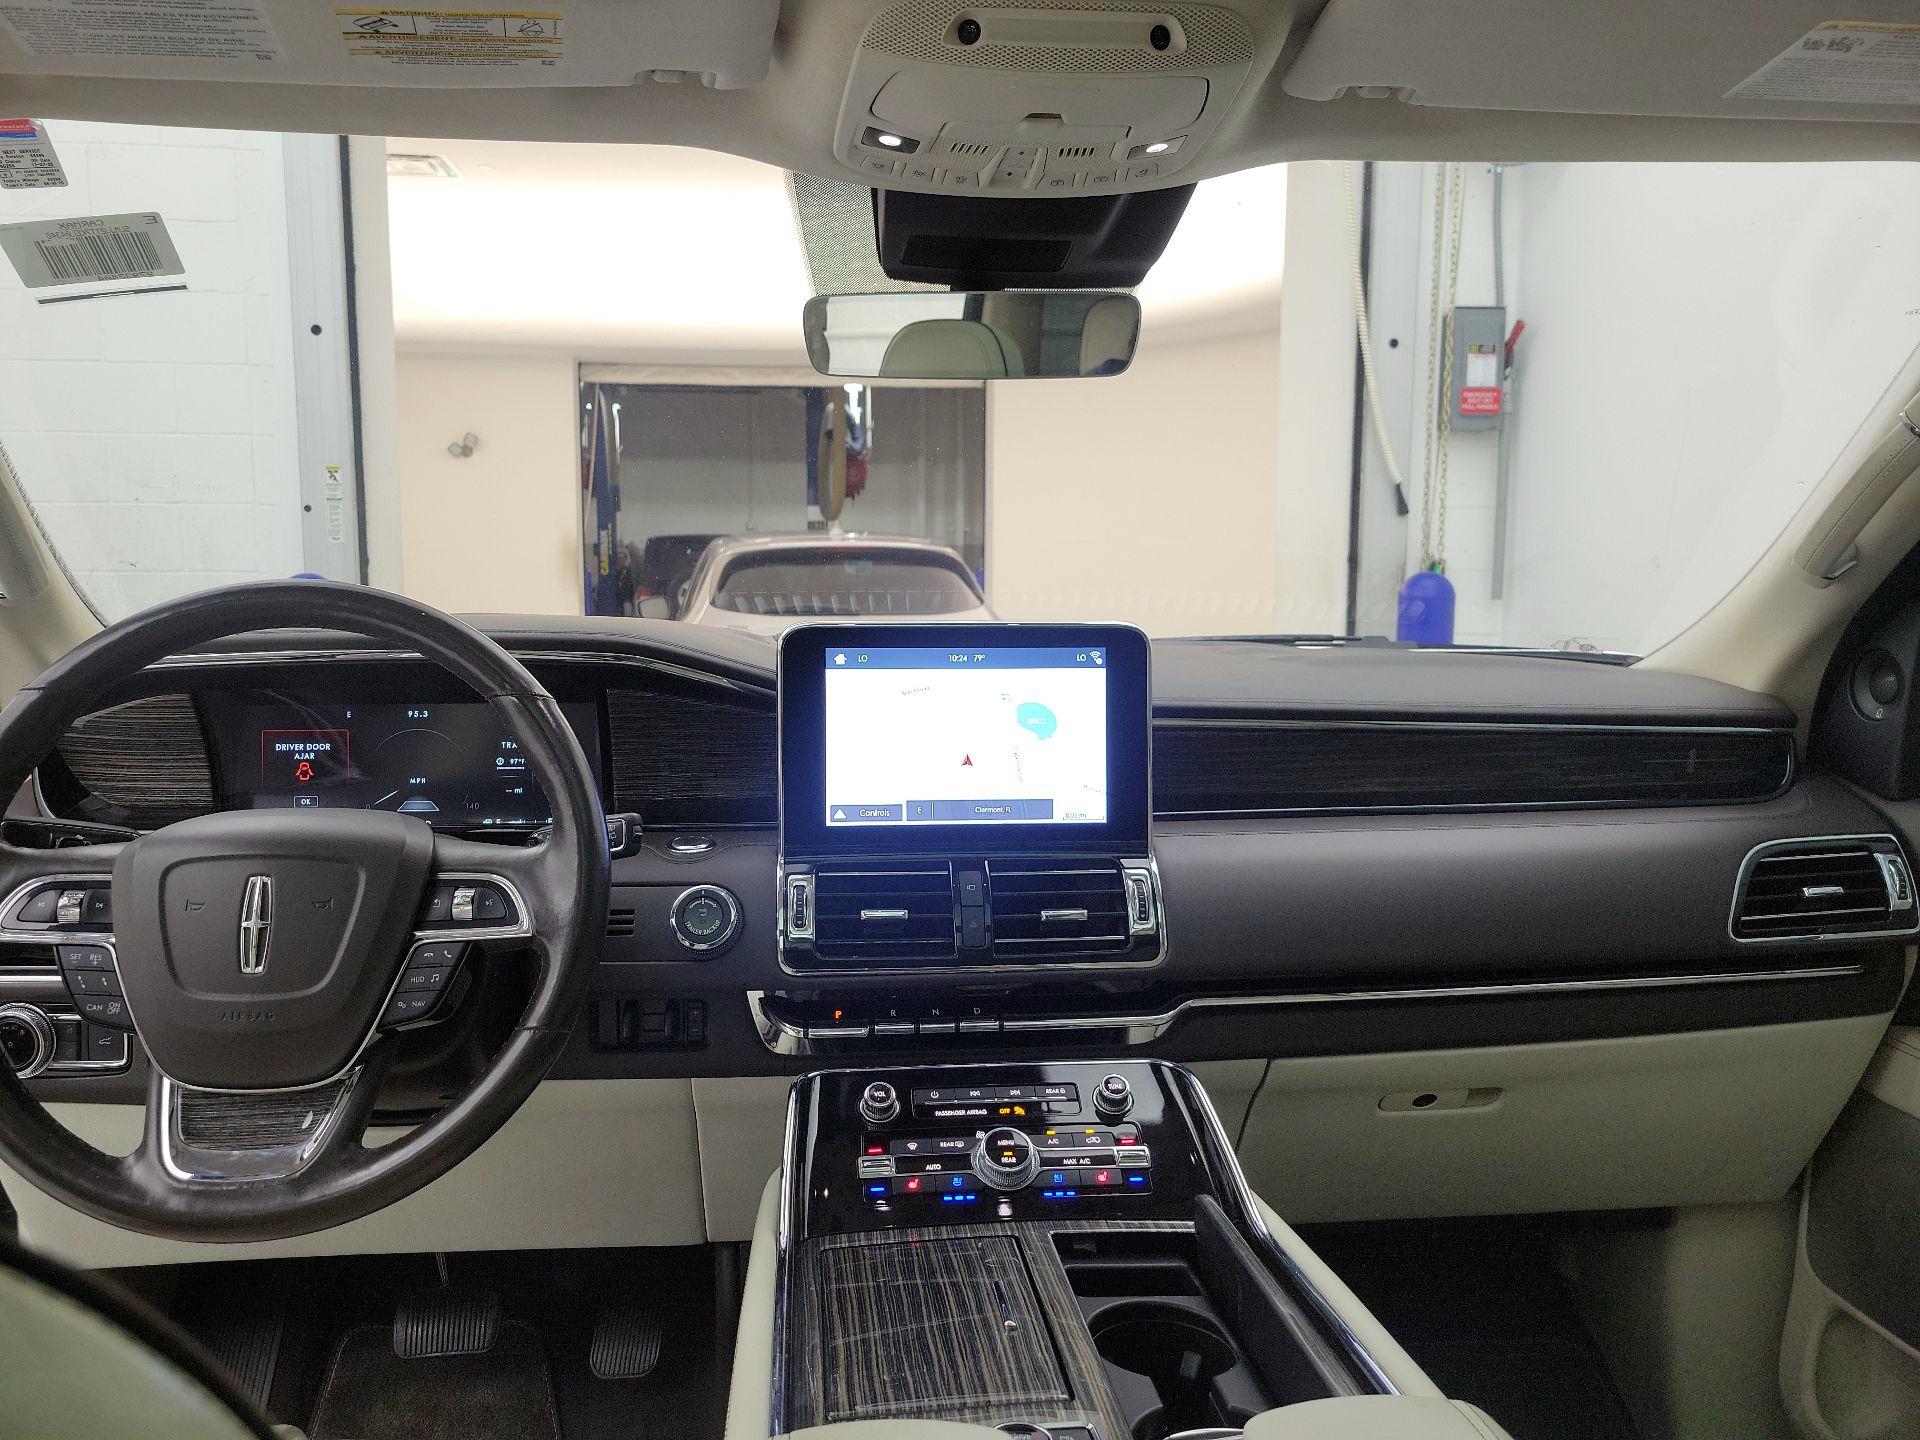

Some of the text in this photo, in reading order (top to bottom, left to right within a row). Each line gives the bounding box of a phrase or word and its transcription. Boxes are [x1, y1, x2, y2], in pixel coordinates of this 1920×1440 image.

[857, 653, 869, 663] LO
[948, 653, 969, 663] 10:24
[1076, 653, 1087, 662] LO
[346, 711, 352, 719] E
[407, 710, 430, 718] 95.3
[275, 742, 331, 752] DRIVER DOOR
[294, 752, 316, 760] AJAR
[409, 777, 427, 785] MPH
[300, 798, 311, 806] OK
[464, 802, 480, 810] 140
[859, 808, 892, 818] Controls
[917, 806, 922, 815] E
[86, 1003, 103, 1011] CAN
[973, 1007, 981, 1015] D
[835, 1010, 842, 1018] P
[890, 1009, 897, 1017] R
[932, 1008, 940, 1016] N
[934, 1108, 988, 1117] PASSENGER AIRBAG
